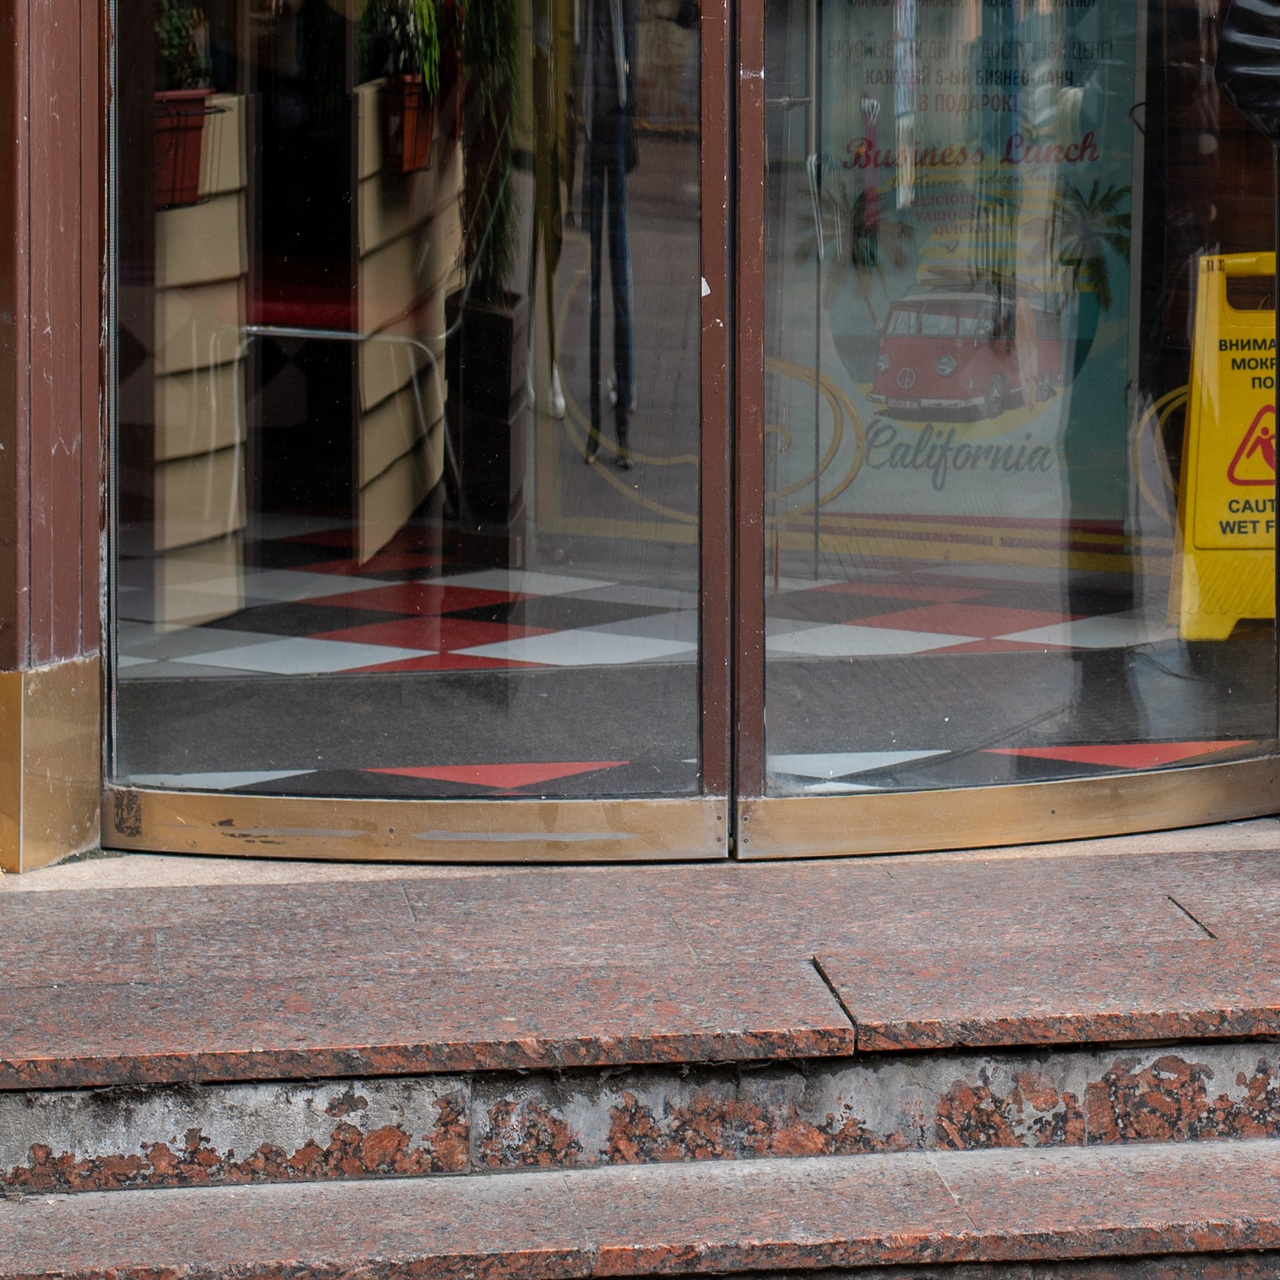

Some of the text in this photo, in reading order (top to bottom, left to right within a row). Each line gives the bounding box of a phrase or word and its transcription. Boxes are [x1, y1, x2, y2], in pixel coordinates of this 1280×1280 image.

[842, 130, 1101, 170] Business Lunch
[905, 193, 977, 207] ELICIOUS
[864, 418, 1053, 492] California
[1219, 520, 1259, 535] WET
